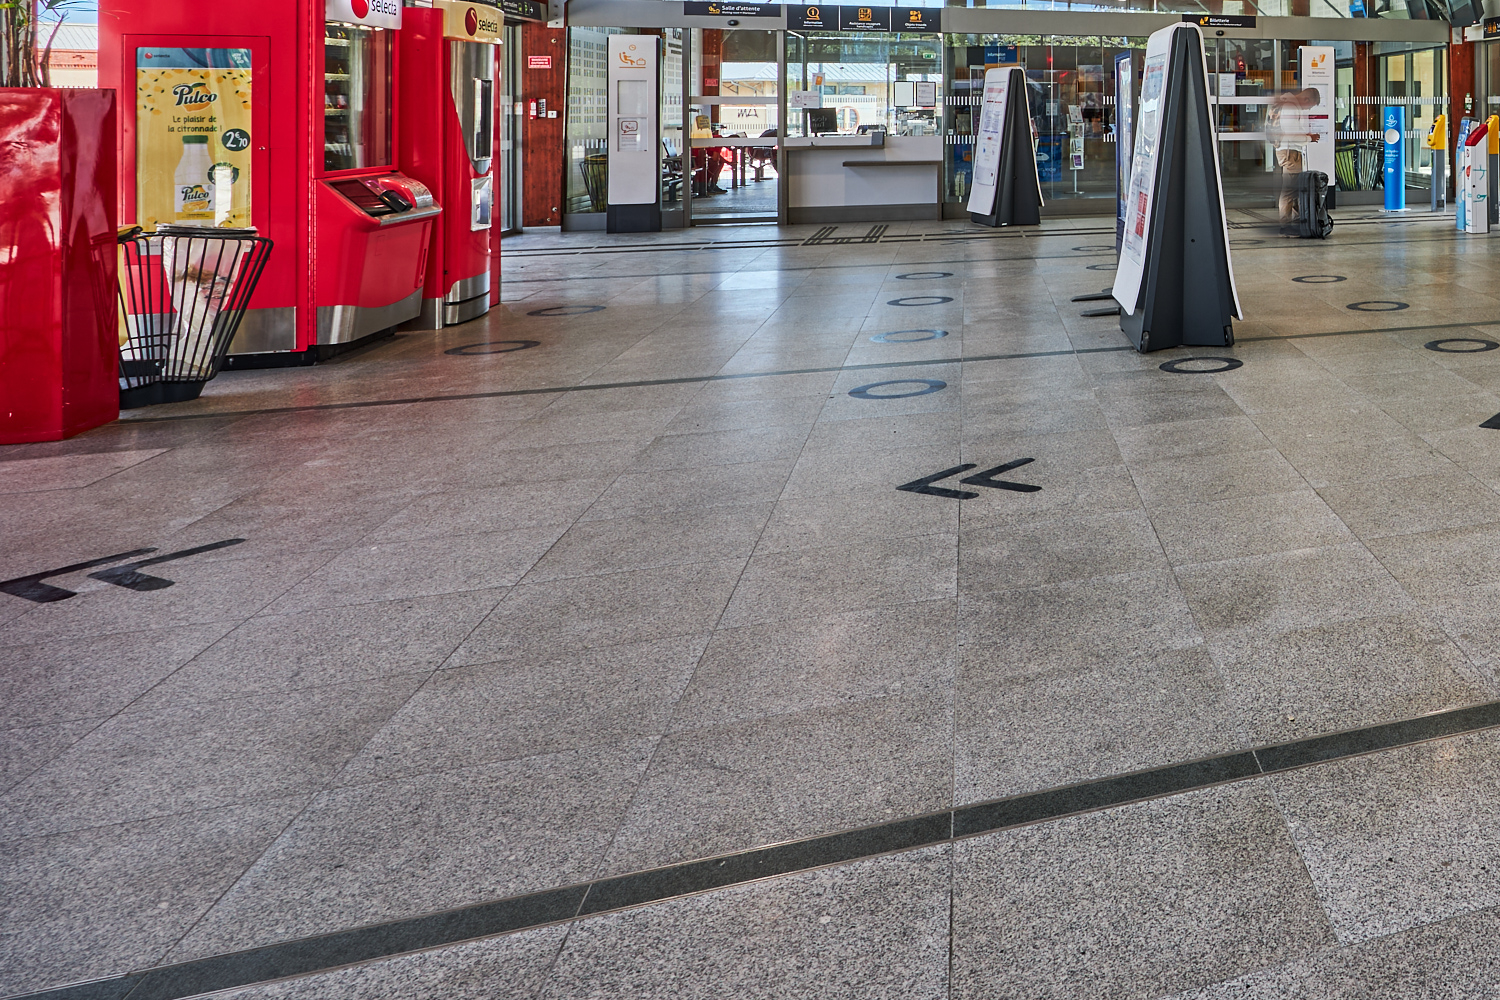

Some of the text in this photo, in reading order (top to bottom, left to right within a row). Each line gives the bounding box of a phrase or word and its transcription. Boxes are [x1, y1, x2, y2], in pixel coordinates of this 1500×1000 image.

[478, 18, 498, 33] selecta
[173, 84, 217, 106] Pulco
[183, 116, 206, 124] plaisir
[182, 187, 209, 201] Pulco
